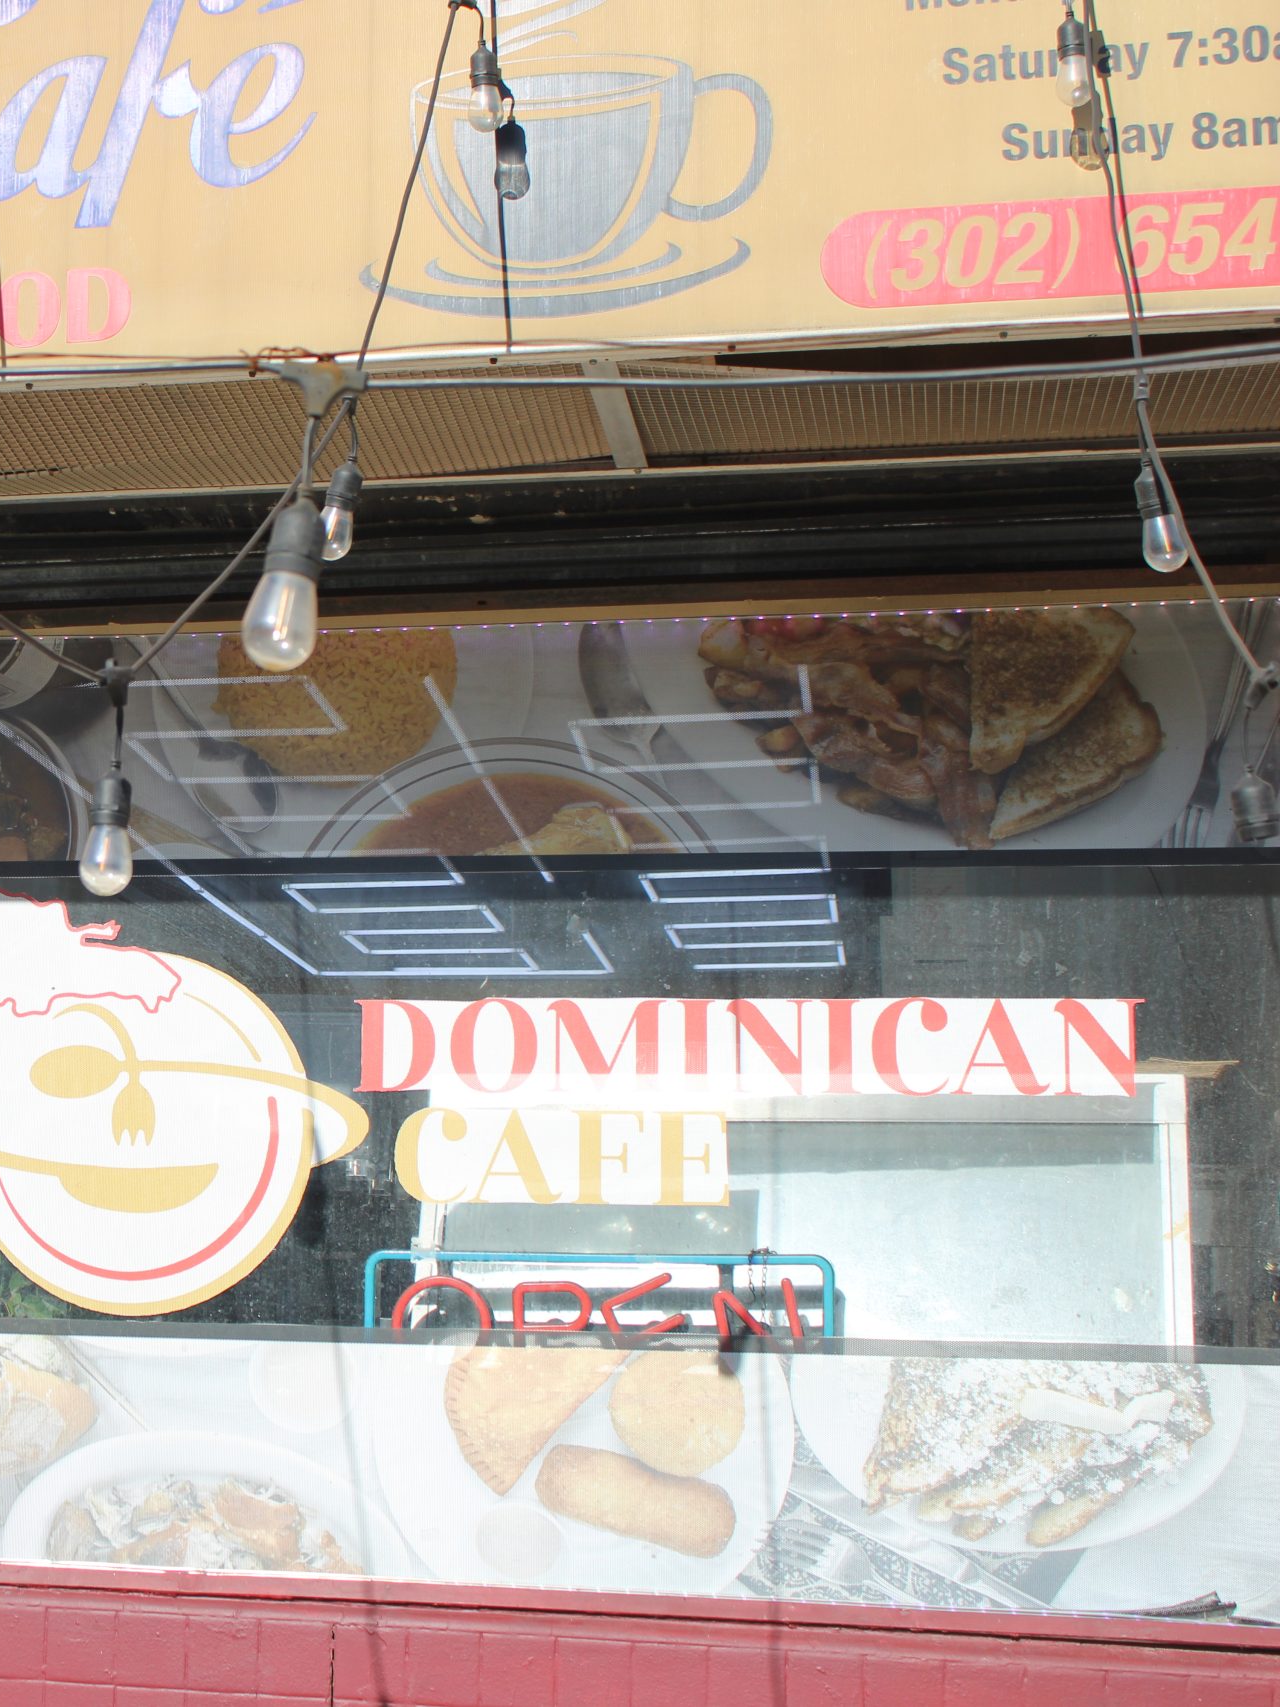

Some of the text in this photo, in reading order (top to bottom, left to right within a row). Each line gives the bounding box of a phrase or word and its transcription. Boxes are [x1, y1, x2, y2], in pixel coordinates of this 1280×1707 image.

[865, 198, 1278, 300] (302) 654
[355, 998, 1145, 1097] DOMINICAN
[395, 1107, 729, 1205] CAFE
